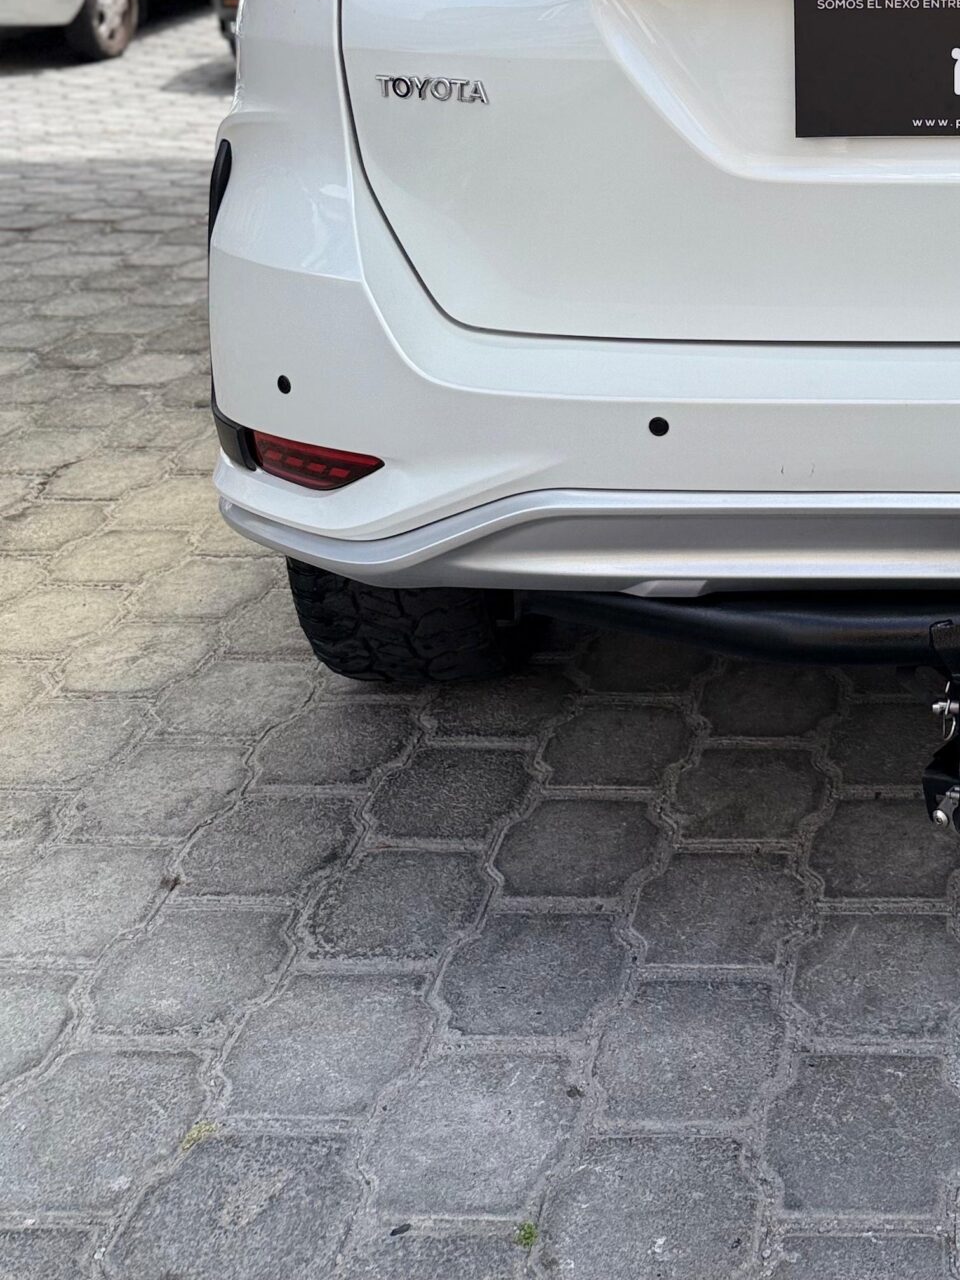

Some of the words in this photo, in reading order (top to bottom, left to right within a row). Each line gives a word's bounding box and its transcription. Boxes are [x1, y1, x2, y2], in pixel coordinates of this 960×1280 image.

[817, 0, 864, 10] SOMOS
[867, 0, 882, 9] EL
[885, 0, 920, 9] NEXO
[375, 75, 489, 104] TOYOTA
